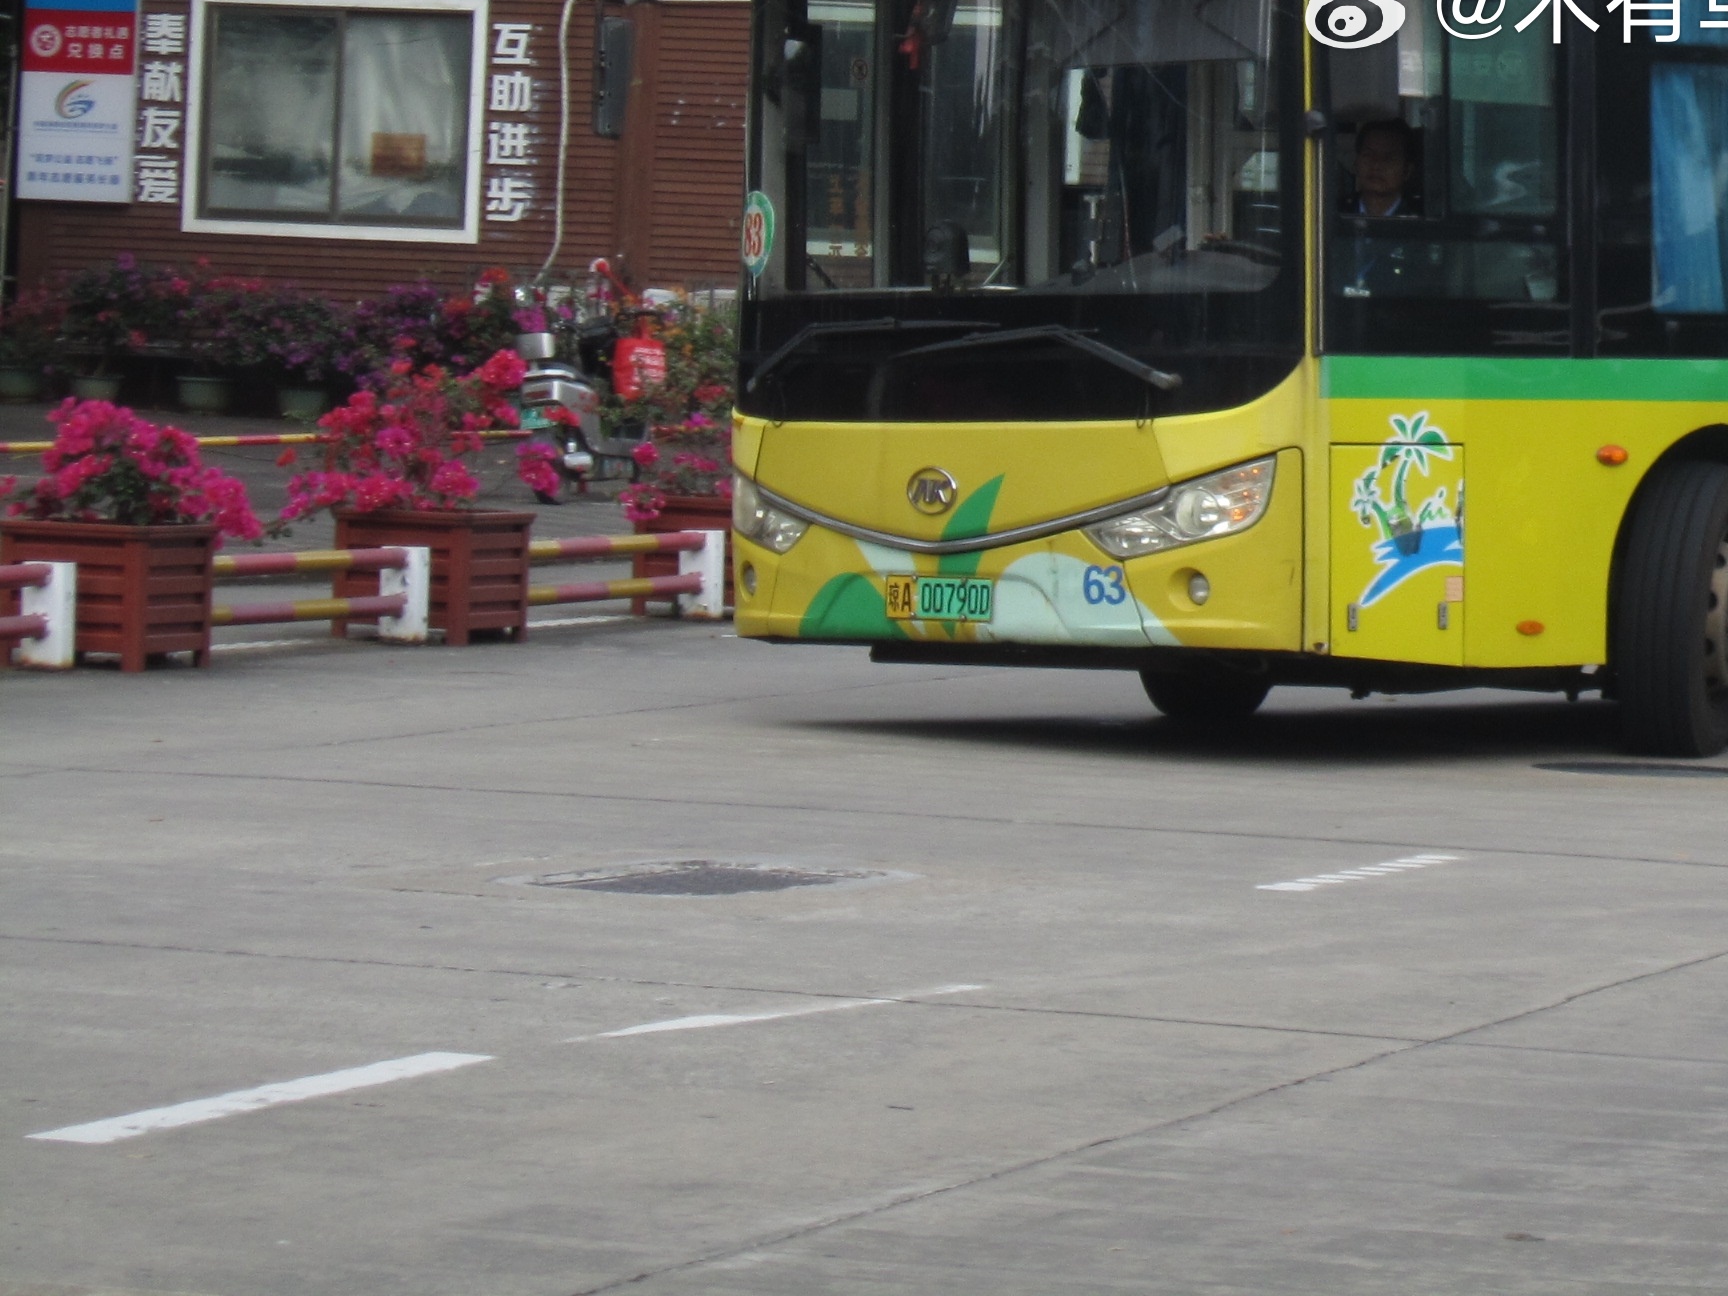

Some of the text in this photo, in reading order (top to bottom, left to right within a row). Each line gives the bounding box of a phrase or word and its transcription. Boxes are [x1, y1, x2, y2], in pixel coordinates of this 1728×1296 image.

[135, 13, 188, 203] 奉献友爱
[485, 23, 534, 222] 互助进步
[1082, 565, 1126, 605] 63
